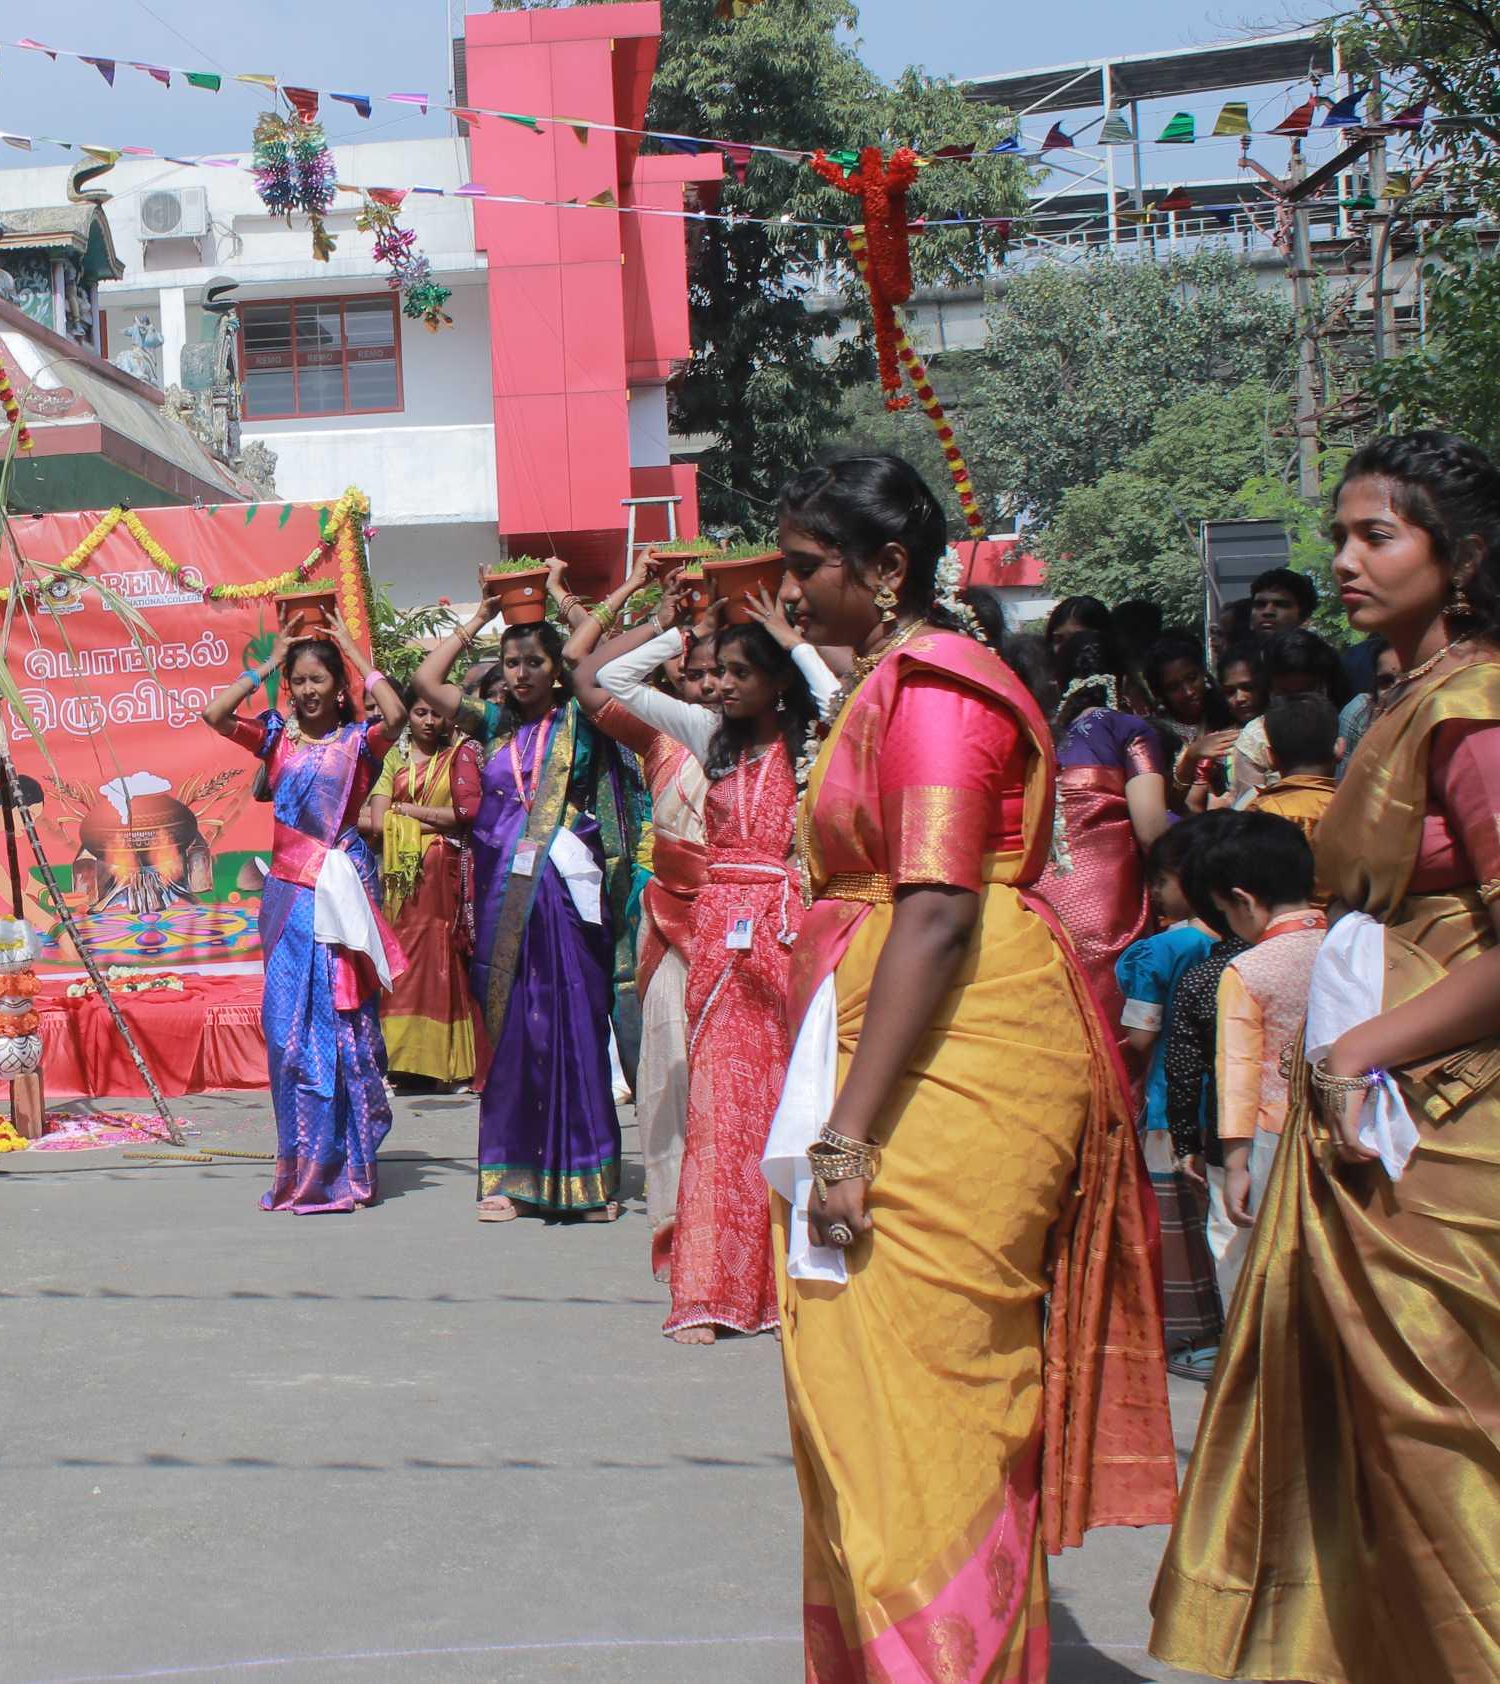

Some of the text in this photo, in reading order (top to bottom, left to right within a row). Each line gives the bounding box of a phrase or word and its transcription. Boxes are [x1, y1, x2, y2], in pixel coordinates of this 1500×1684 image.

[307, 353, 333, 361] REMO
[358, 350, 384, 358] REMO
[256, 356, 282, 365] REMO
[24, 631, 229, 680] பொங்கல்
